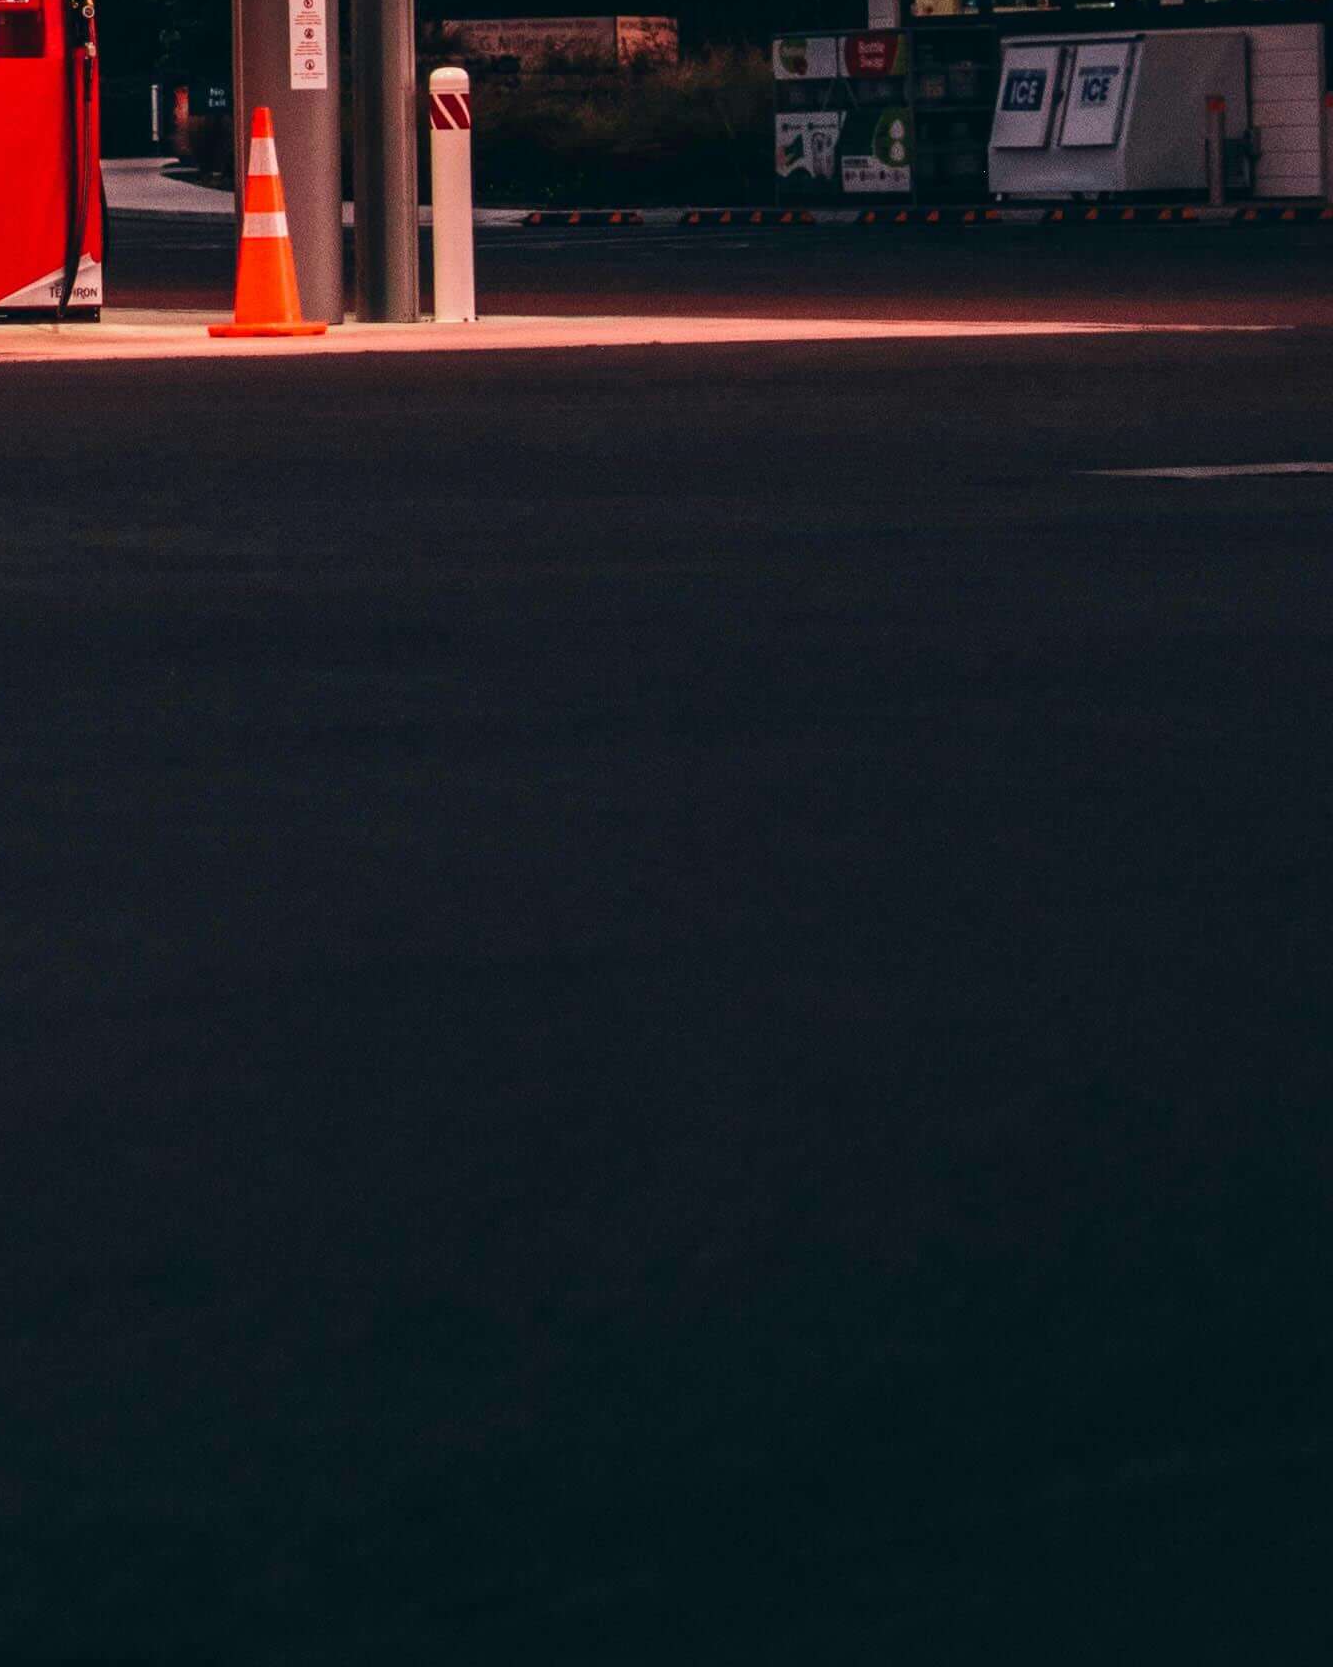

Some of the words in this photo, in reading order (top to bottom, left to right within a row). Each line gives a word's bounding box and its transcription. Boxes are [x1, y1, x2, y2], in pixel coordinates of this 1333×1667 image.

[1009, 79, 1039, 105] ICE
[1081, 76, 1111, 102] ICE
[49, 286, 98, 300] TERON
